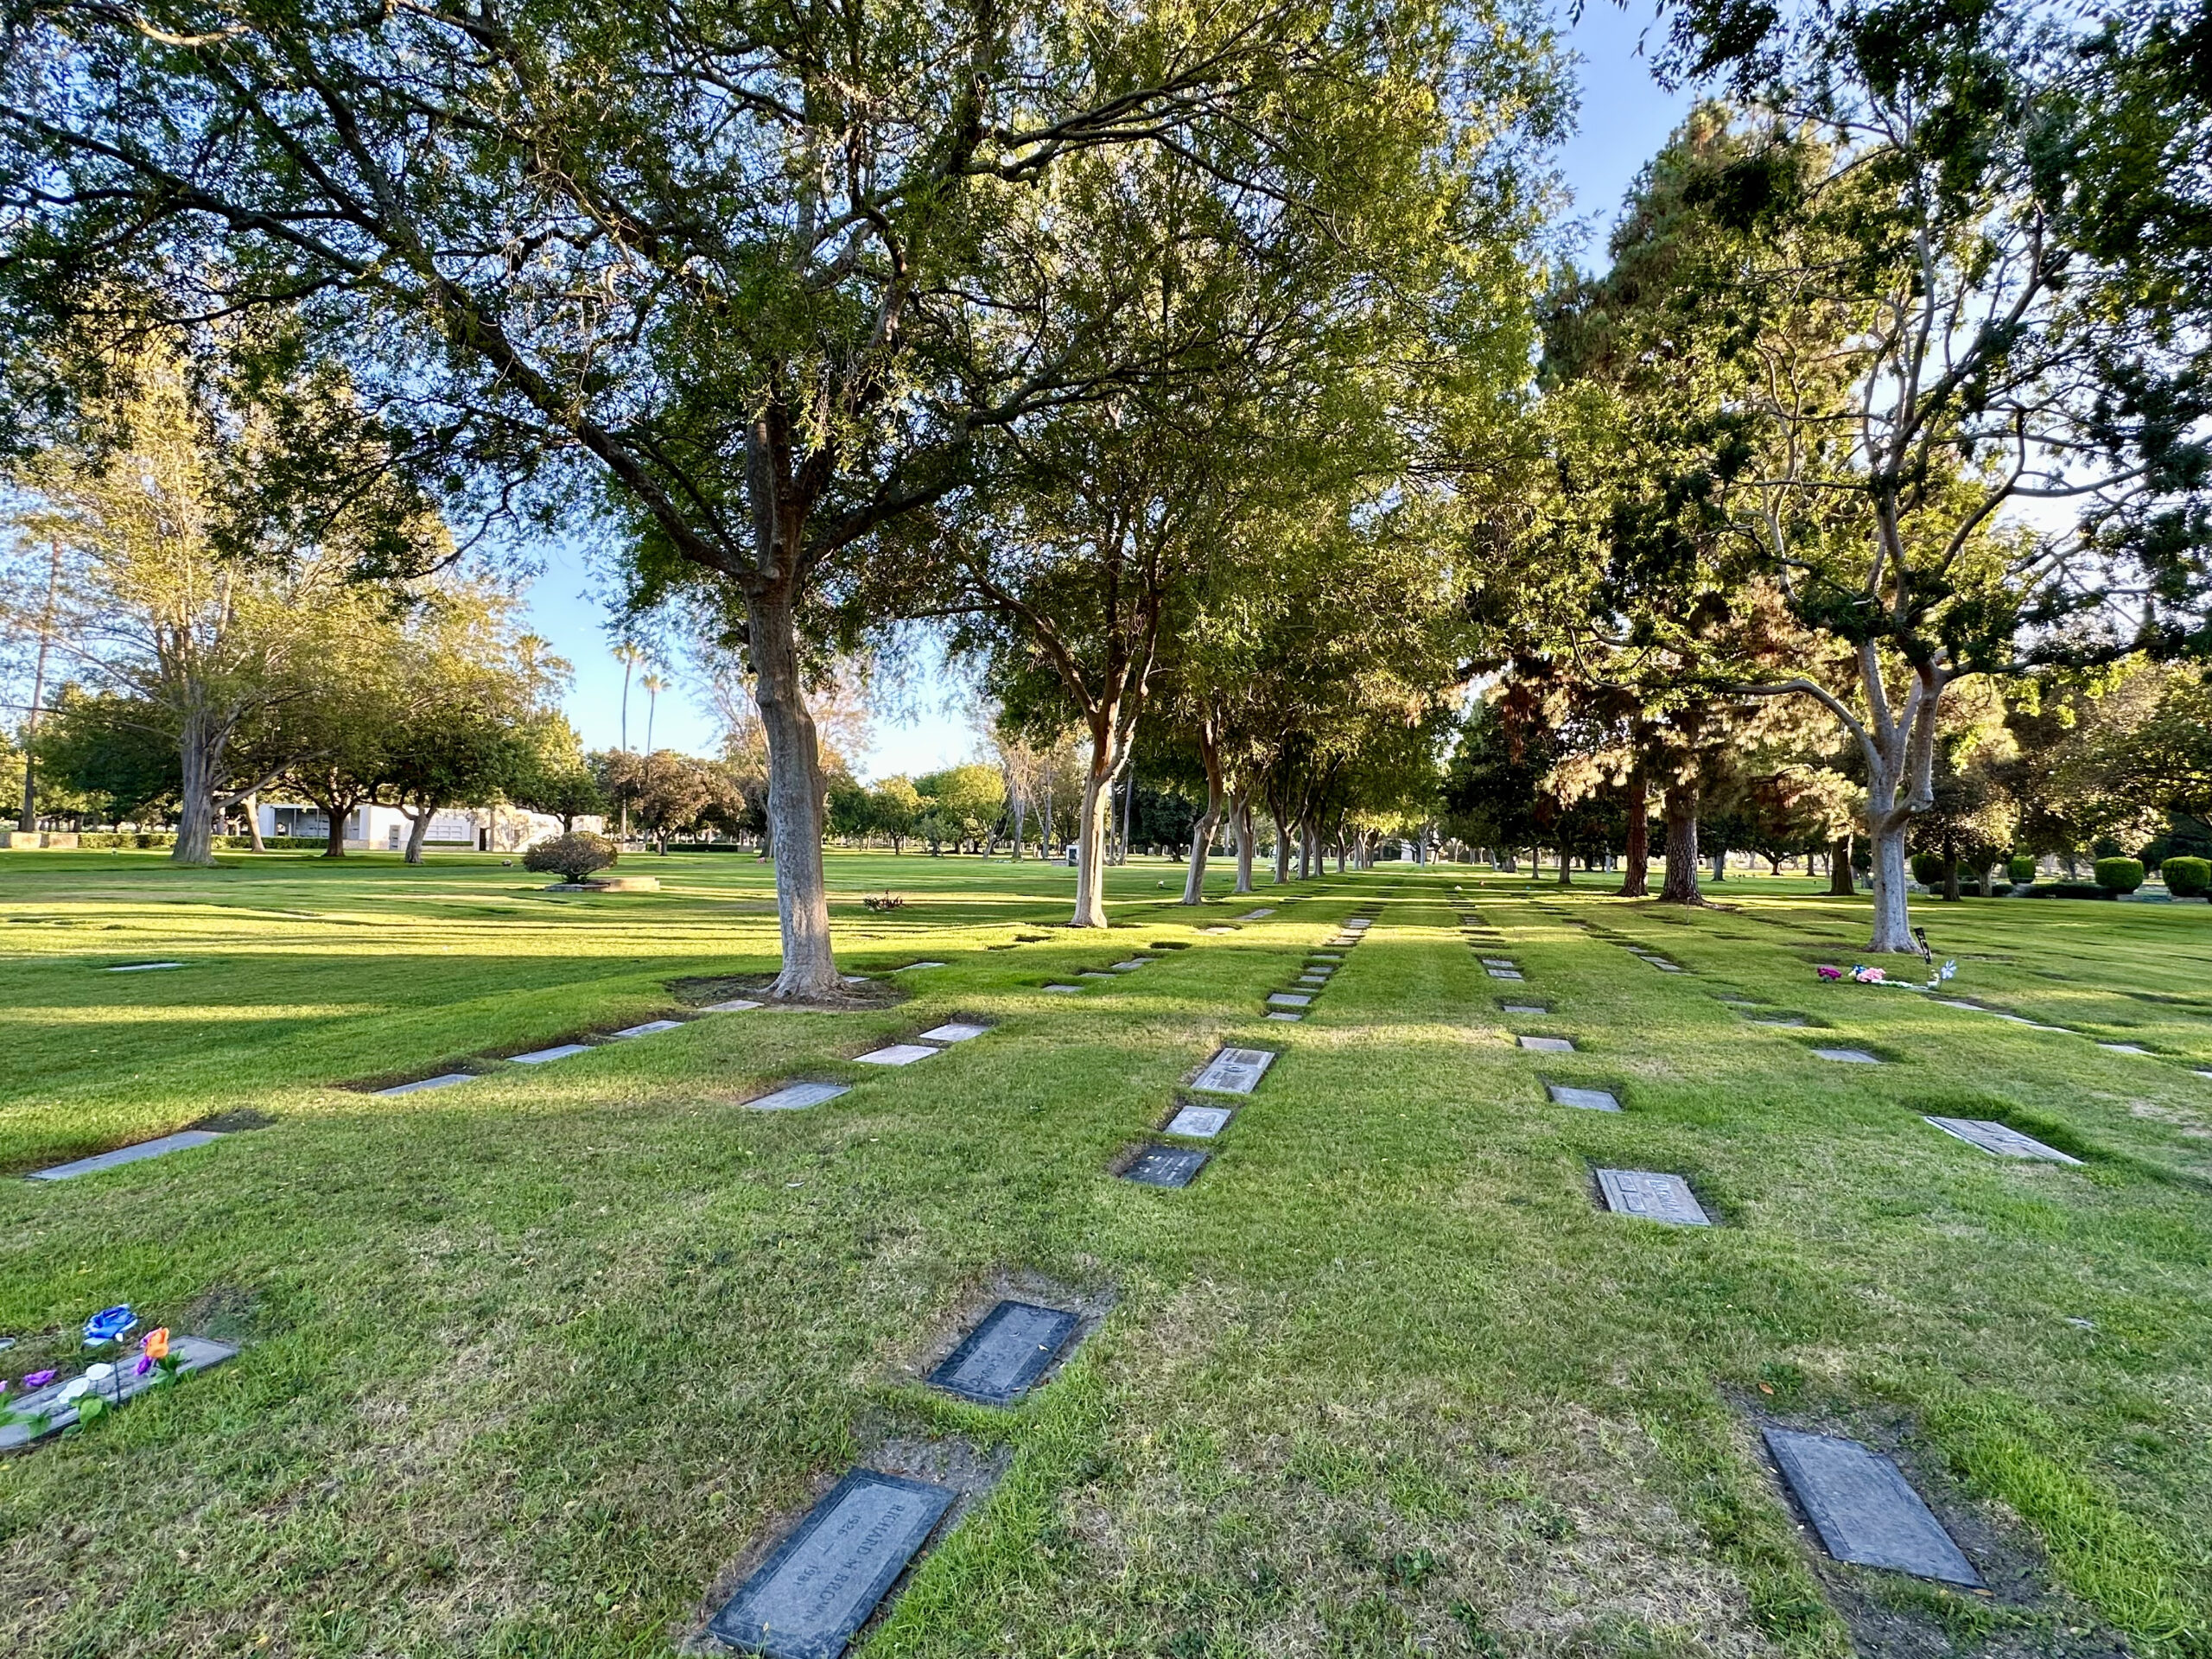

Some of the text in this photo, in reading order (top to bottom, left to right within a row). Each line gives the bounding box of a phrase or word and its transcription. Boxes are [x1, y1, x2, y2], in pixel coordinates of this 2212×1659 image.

[836, 1515, 861, 1535] 1926
[857, 1503, 906, 1555] RICHARD
[792, 1565, 819, 1586] 1981
[803, 1573, 849, 1622] BROWN
